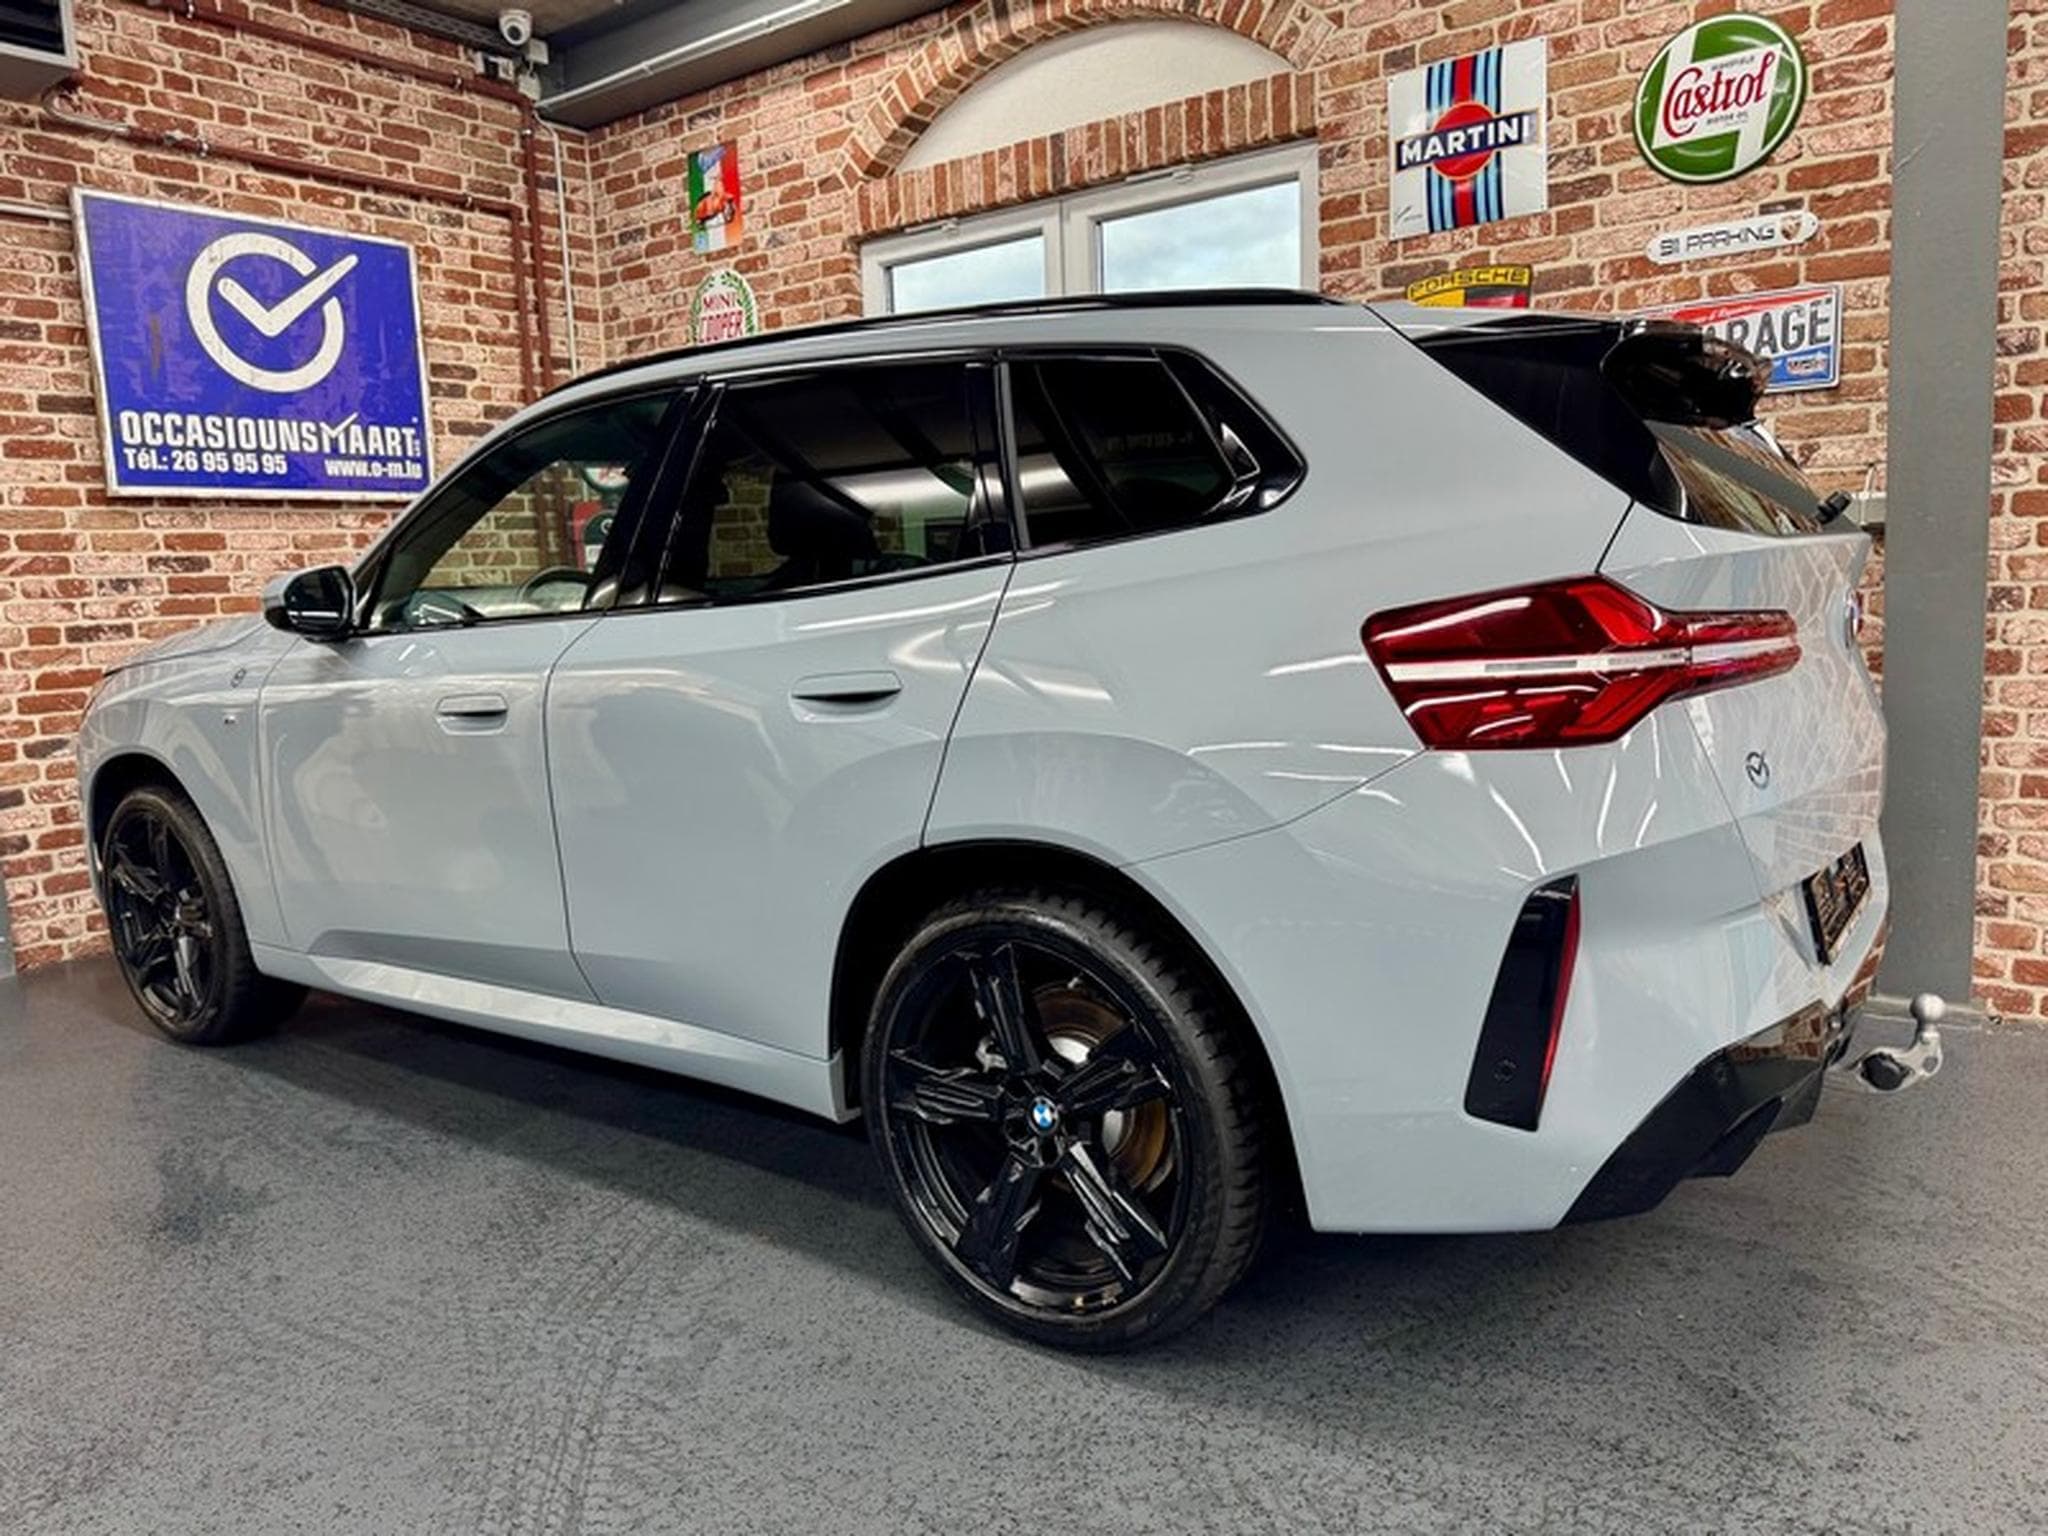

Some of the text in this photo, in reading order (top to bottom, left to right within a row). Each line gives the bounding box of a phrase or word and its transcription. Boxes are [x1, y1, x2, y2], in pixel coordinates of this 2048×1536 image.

[1663, 51, 1775, 138] Castrol
[1401, 116, 1530, 166] MARTINI
[1686, 223, 1775, 251] PARKING
[1411, 266, 1526, 298] PORSCHE
[119, 411, 418, 457] OCCASIOUNSMAART
[123, 448, 287, 476] Tél.: 26 95 95 95
